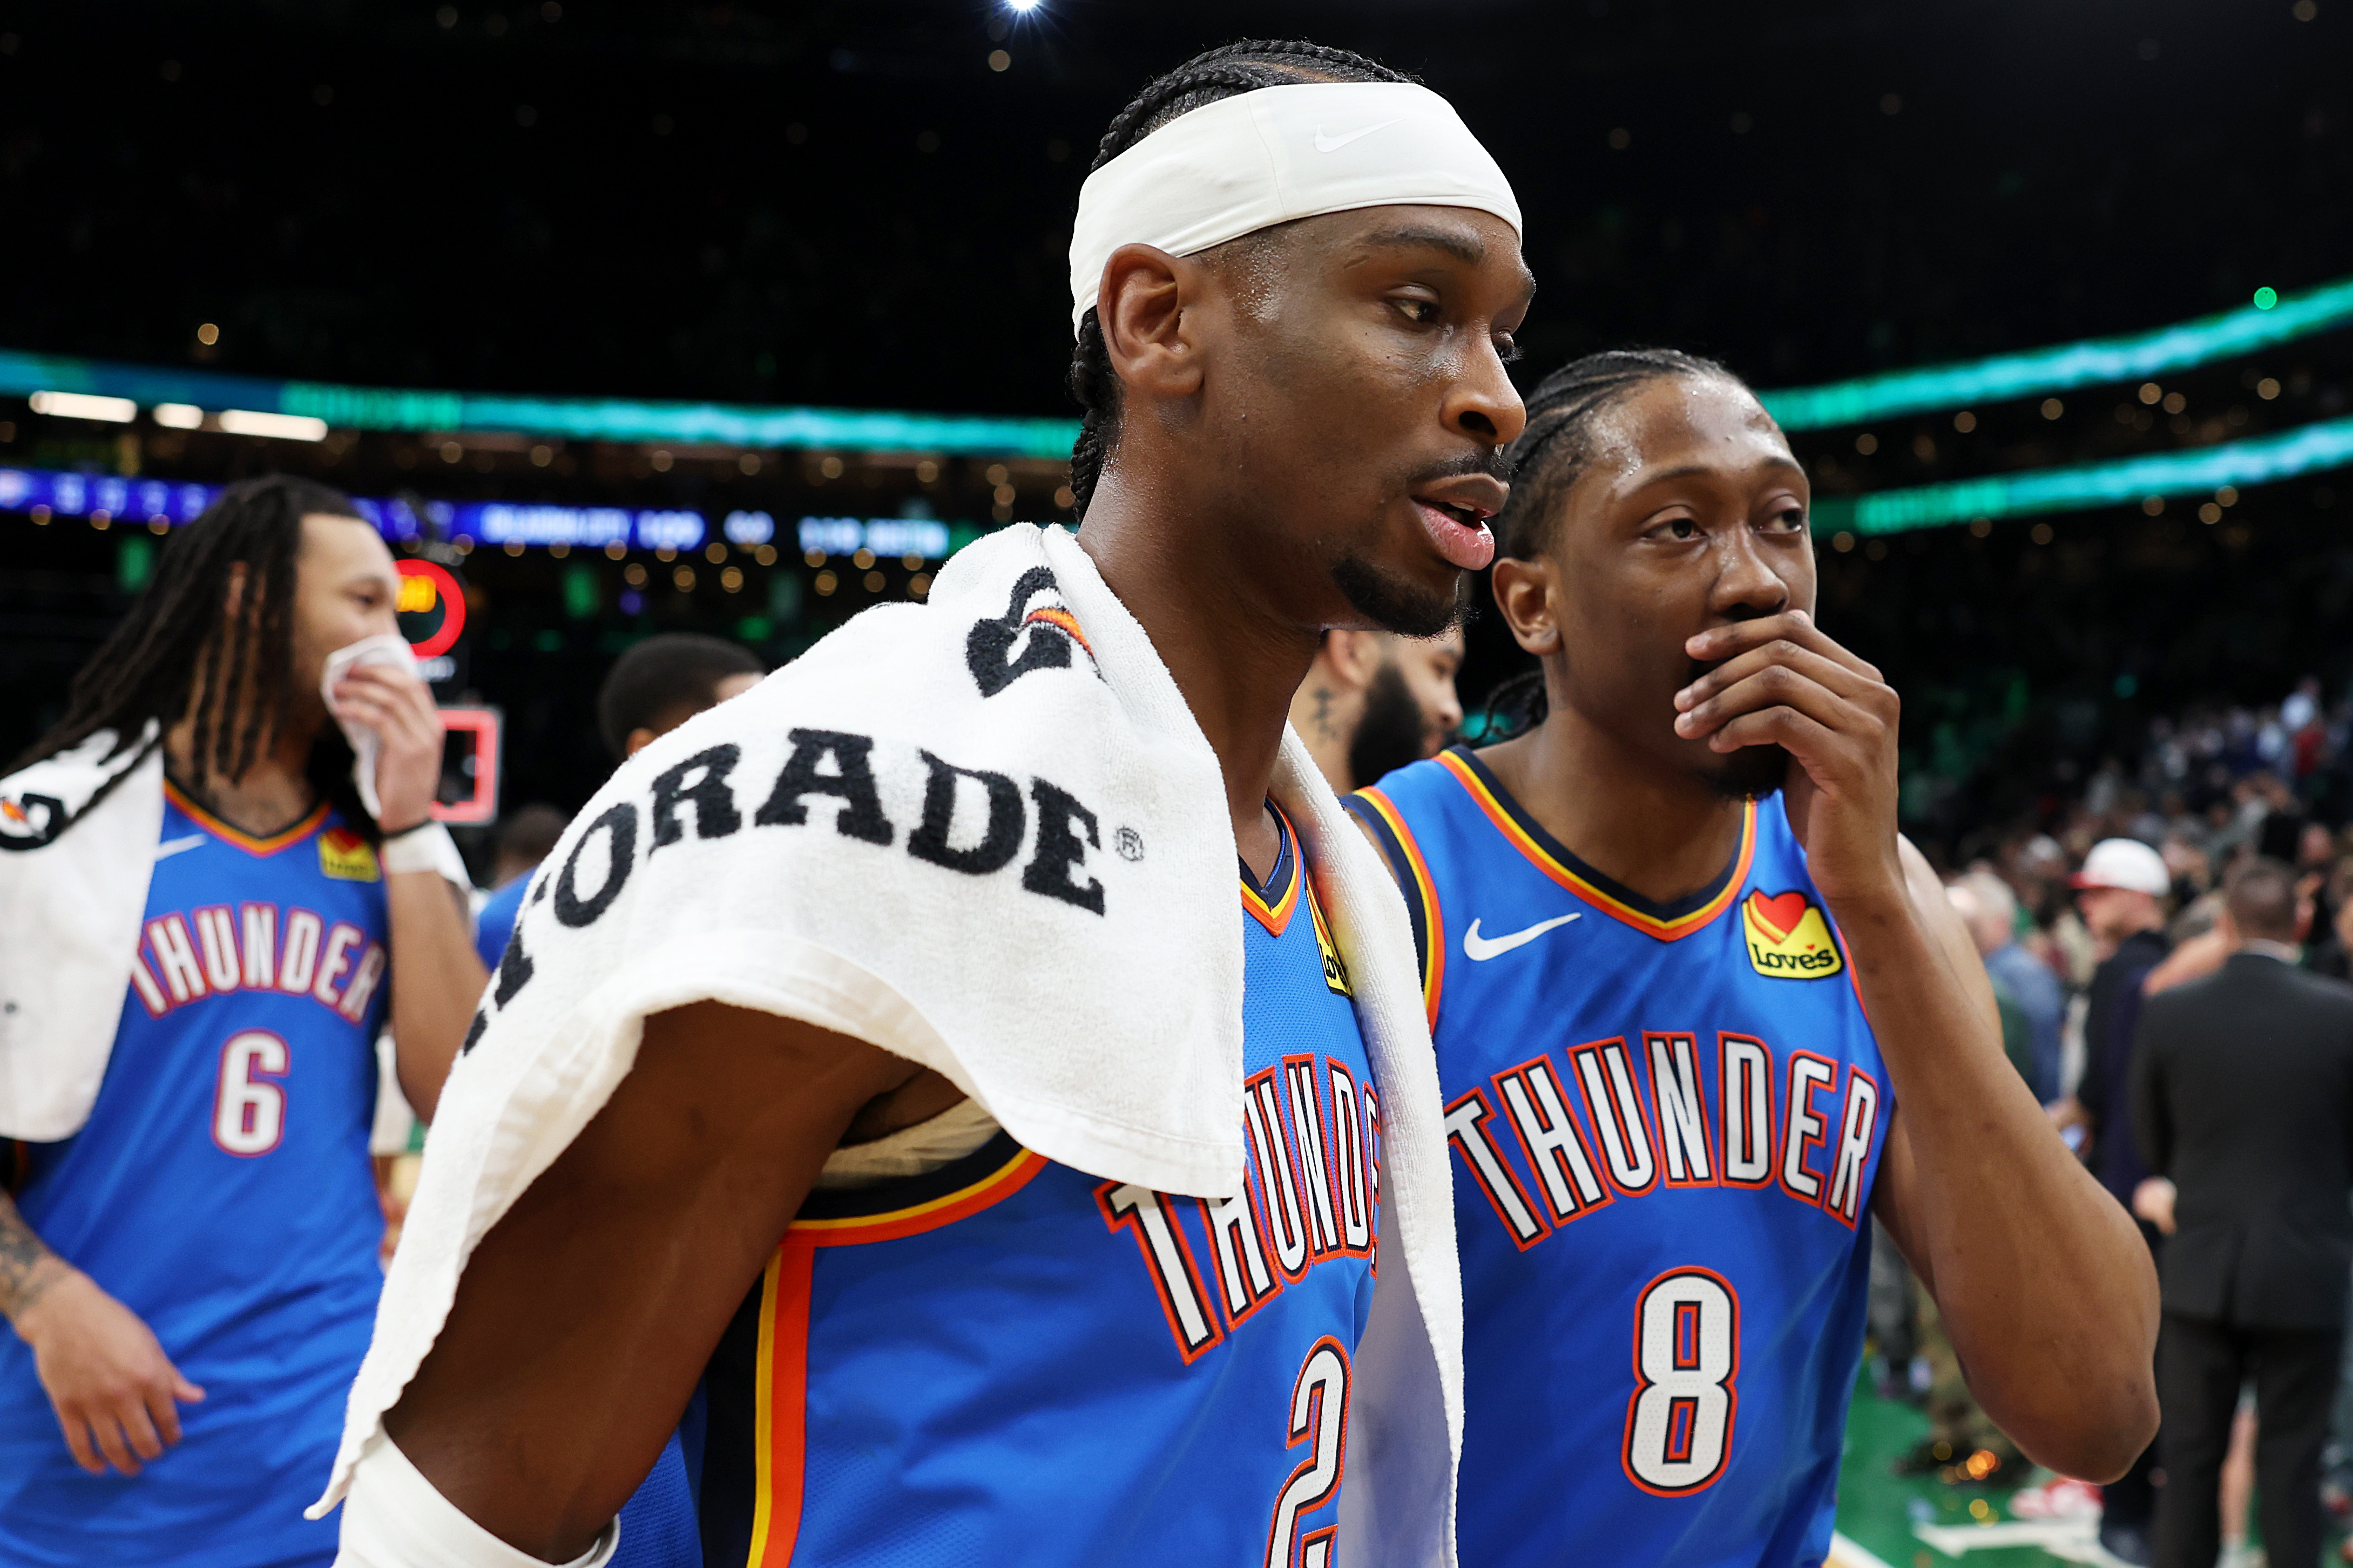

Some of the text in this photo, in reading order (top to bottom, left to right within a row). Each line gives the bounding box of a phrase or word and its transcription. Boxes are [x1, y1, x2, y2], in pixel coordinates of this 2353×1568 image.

[463, 728, 1105, 1056] ORADE
[211, 1028, 291, 1159] 6
[1092, 1053, 1381, 1366] THUNDE
[1443, 1030, 1879, 1253] THUNDER
[1262, 1335, 1353, 1568] 2
[1621, 1265, 1740, 1498] 8
